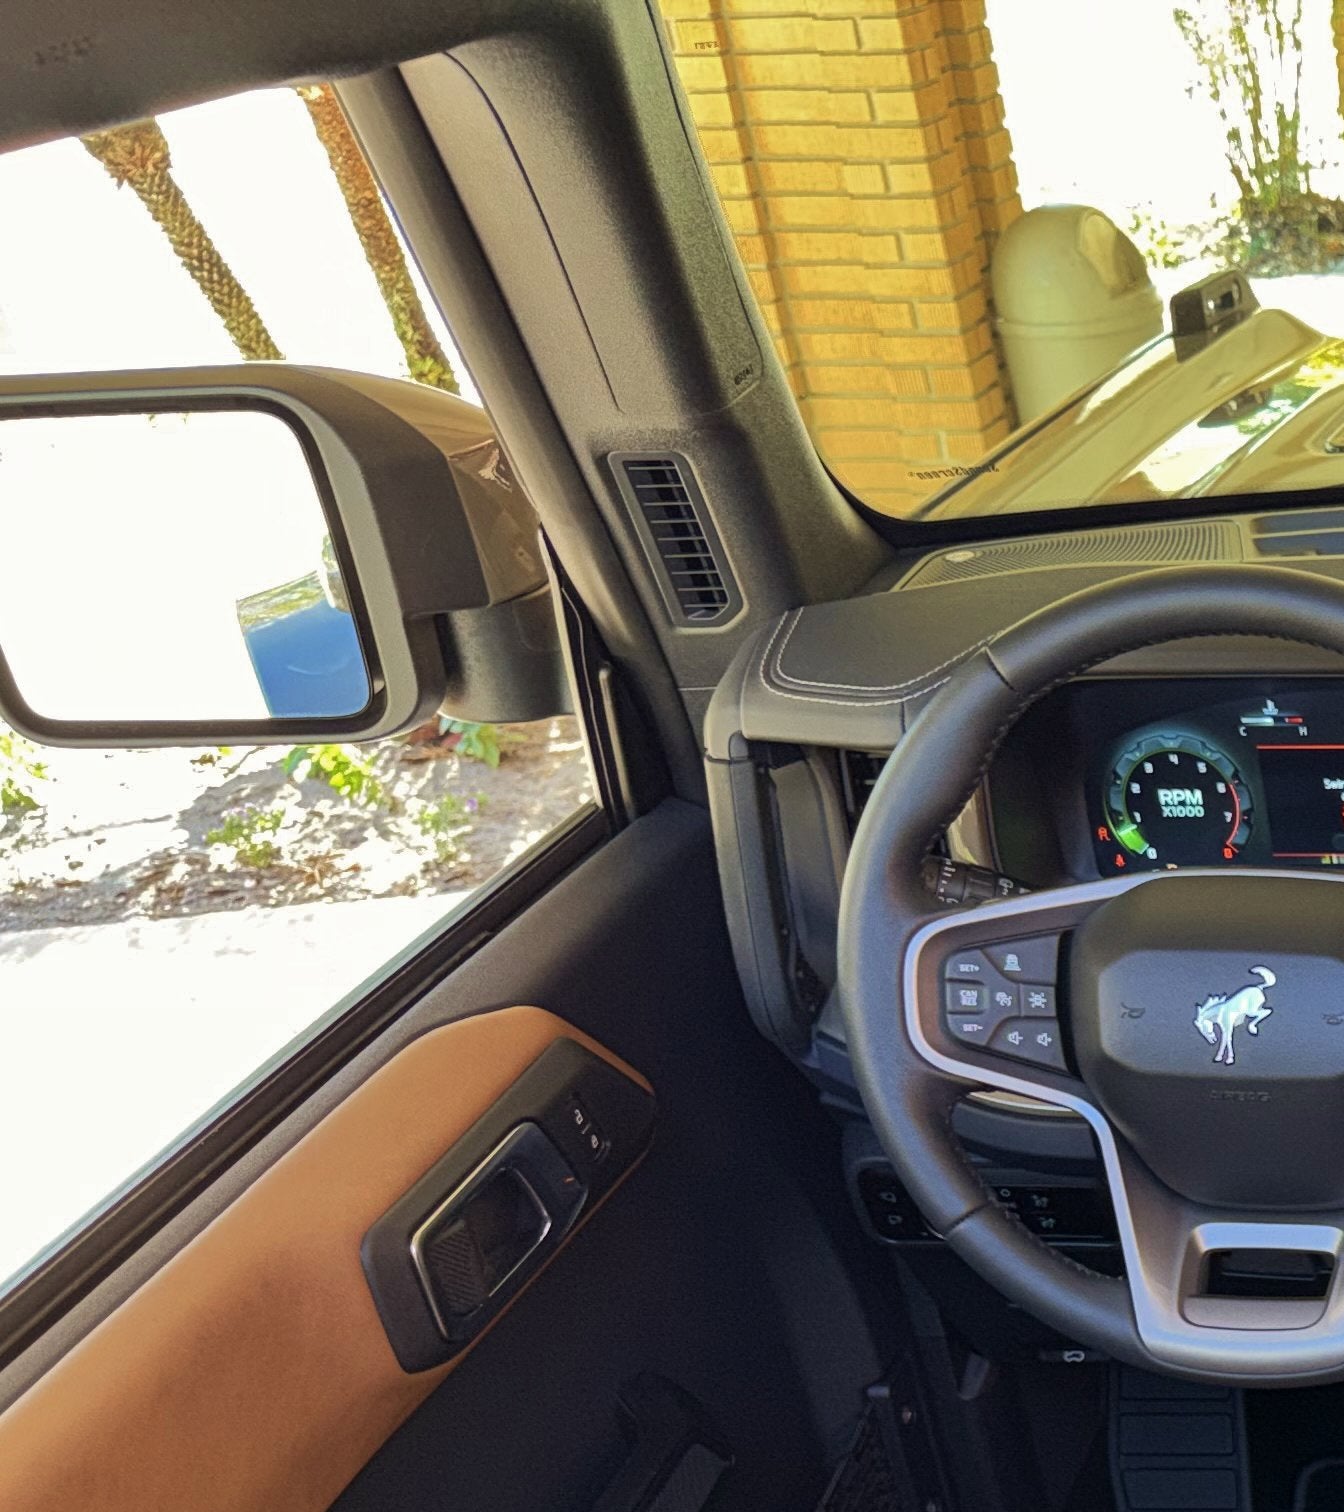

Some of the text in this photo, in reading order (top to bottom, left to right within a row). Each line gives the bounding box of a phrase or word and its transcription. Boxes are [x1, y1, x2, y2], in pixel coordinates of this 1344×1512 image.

[1238, 726, 1248, 737] C
[1298, 725, 1308, 736] H
[1168, 753, 1179, 765] 4
[1143, 761, 1154, 774] 3
[1196, 761, 1207, 774] 5
[1130, 782, 1141, 794] 2
[1216, 781, 1226, 794] 6
[1157, 788, 1204, 806] RPM
[1133, 811, 1142, 823] 1
[1223, 811, 1233, 823] 7
[1146, 847, 1157, 860] 0
